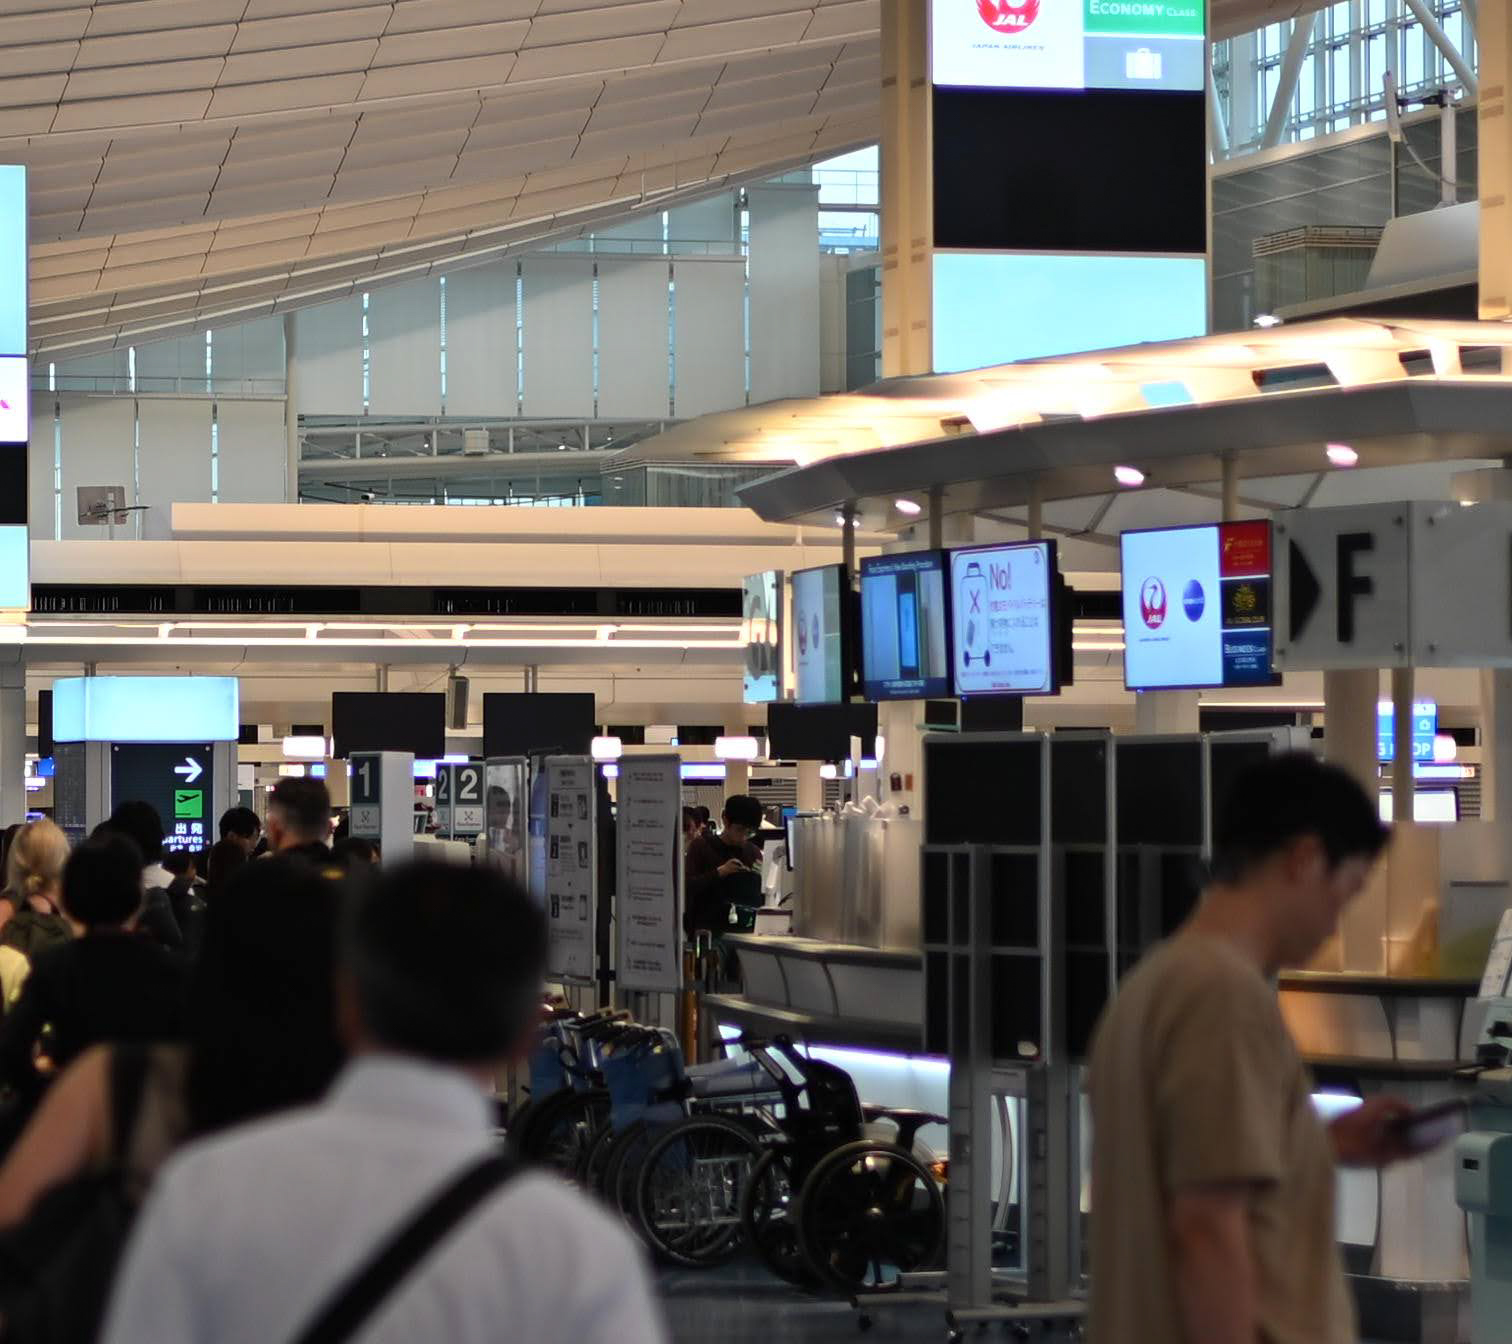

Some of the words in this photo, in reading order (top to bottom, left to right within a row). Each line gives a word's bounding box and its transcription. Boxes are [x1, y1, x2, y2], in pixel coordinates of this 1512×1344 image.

[992, 13, 1032, 27] JAL
[1089, 0, 1165, 17] ECONOMY
[989, 561, 1013, 591] No!
[1337, 532, 1375, 643] F
[358, 760, 371, 798] 1
[437, 767, 449, 800] 2
[459, 768, 478, 800] 2
